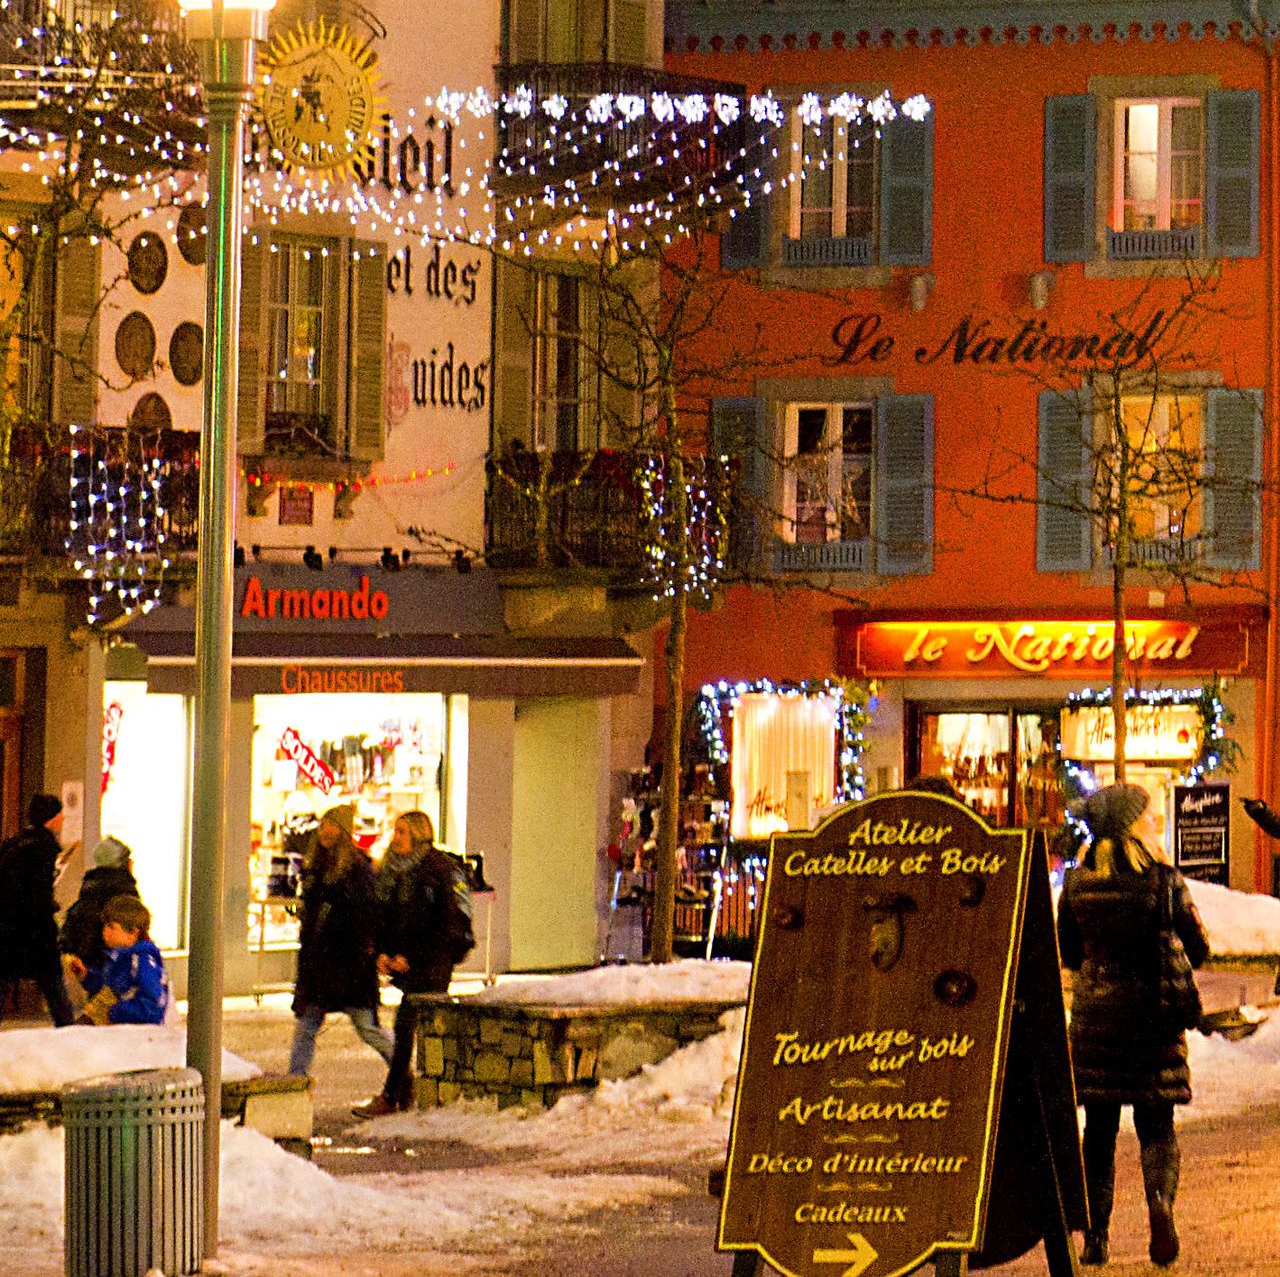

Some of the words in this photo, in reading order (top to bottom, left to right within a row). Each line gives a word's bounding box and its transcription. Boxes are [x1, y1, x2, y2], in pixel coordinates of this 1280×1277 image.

[426, 242, 481, 305] des
[826, 313, 895, 368] Le
[914, 309, 1165, 368] National
[240, 575, 390, 620] Armando
[903, 626, 948, 662] le
[281, 664, 404, 694] Chaussures
[282, 730, 333, 793] SOLDES
[848, 818, 953, 846] Atelier
[785, 848, 895, 876] Catelles
[899, 851, 932, 876] et
[941, 848, 1007, 875] Bois
[773, 1027, 916, 1067] Tournage
[868, 1049, 914, 1074] sur
[918, 1030, 976, 1064] bois
[778, 1094, 951, 1127] Artisanat
[747, 1151, 814, 1175] Déco
[823, 1151, 969, 1175] d'intérieur
[795, 1200, 908, 1224] Cadeaux
